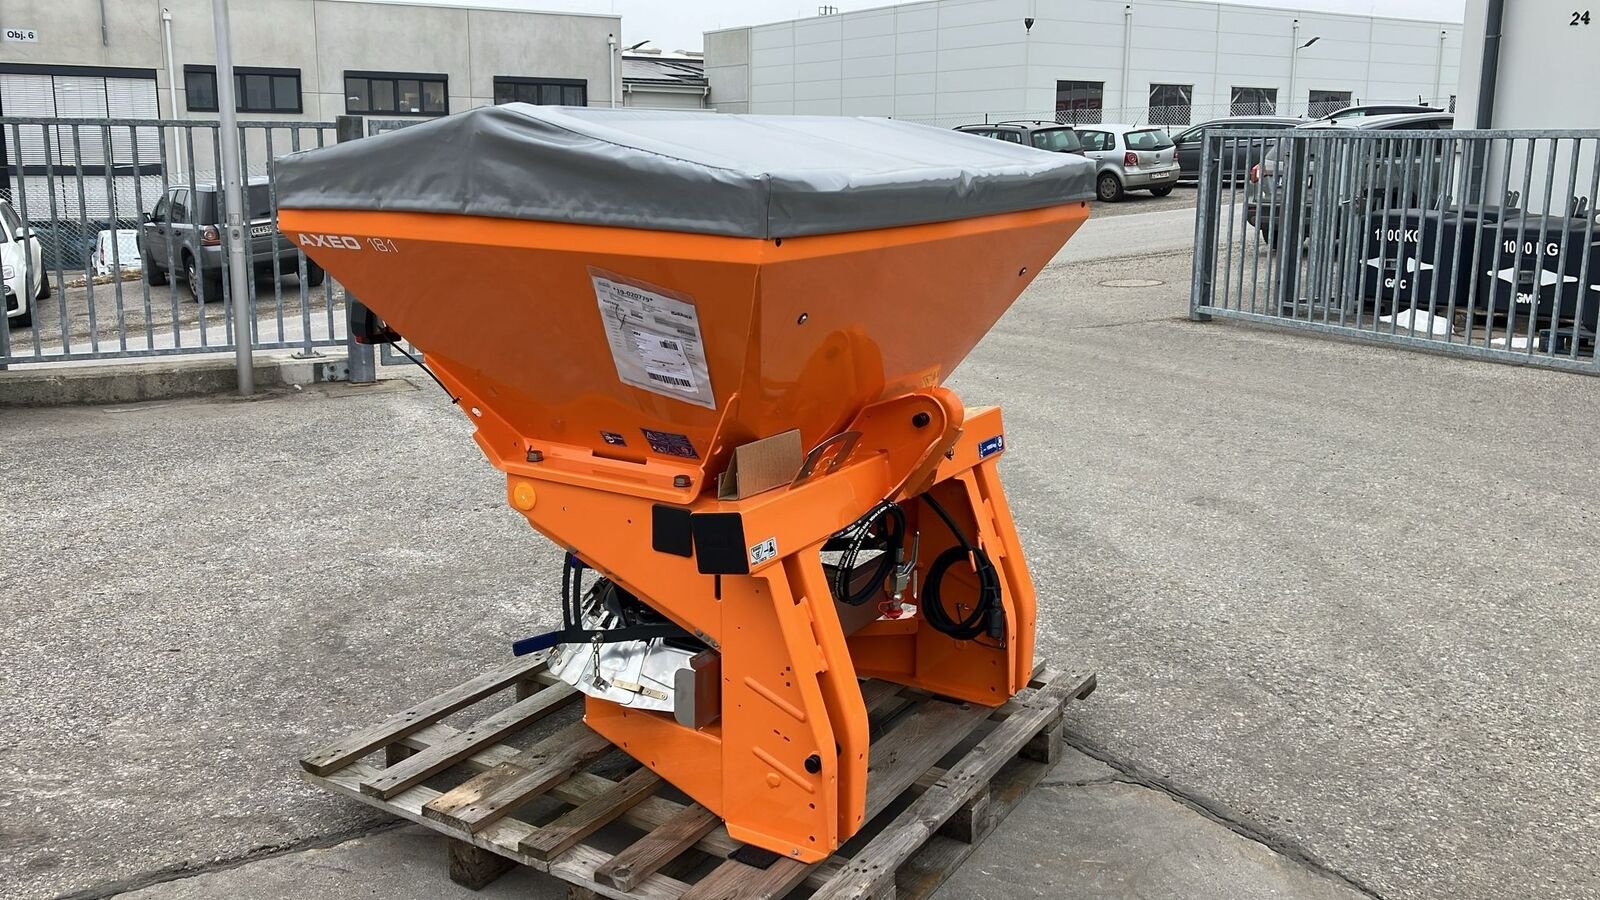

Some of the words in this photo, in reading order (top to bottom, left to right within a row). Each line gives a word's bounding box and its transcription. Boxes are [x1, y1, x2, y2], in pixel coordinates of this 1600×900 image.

[1570, 11, 1590, 25] 24
[7, 31, 26, 40] Obj.
[28, 31, 34, 39] 6
[1374, 228, 1401, 242] 100
[298, 233, 361, 250] AXEO
[366, 237, 399, 253] 18.1
[1503, 240, 1533, 255] 100
[1516, 292, 1541, 305] GM
